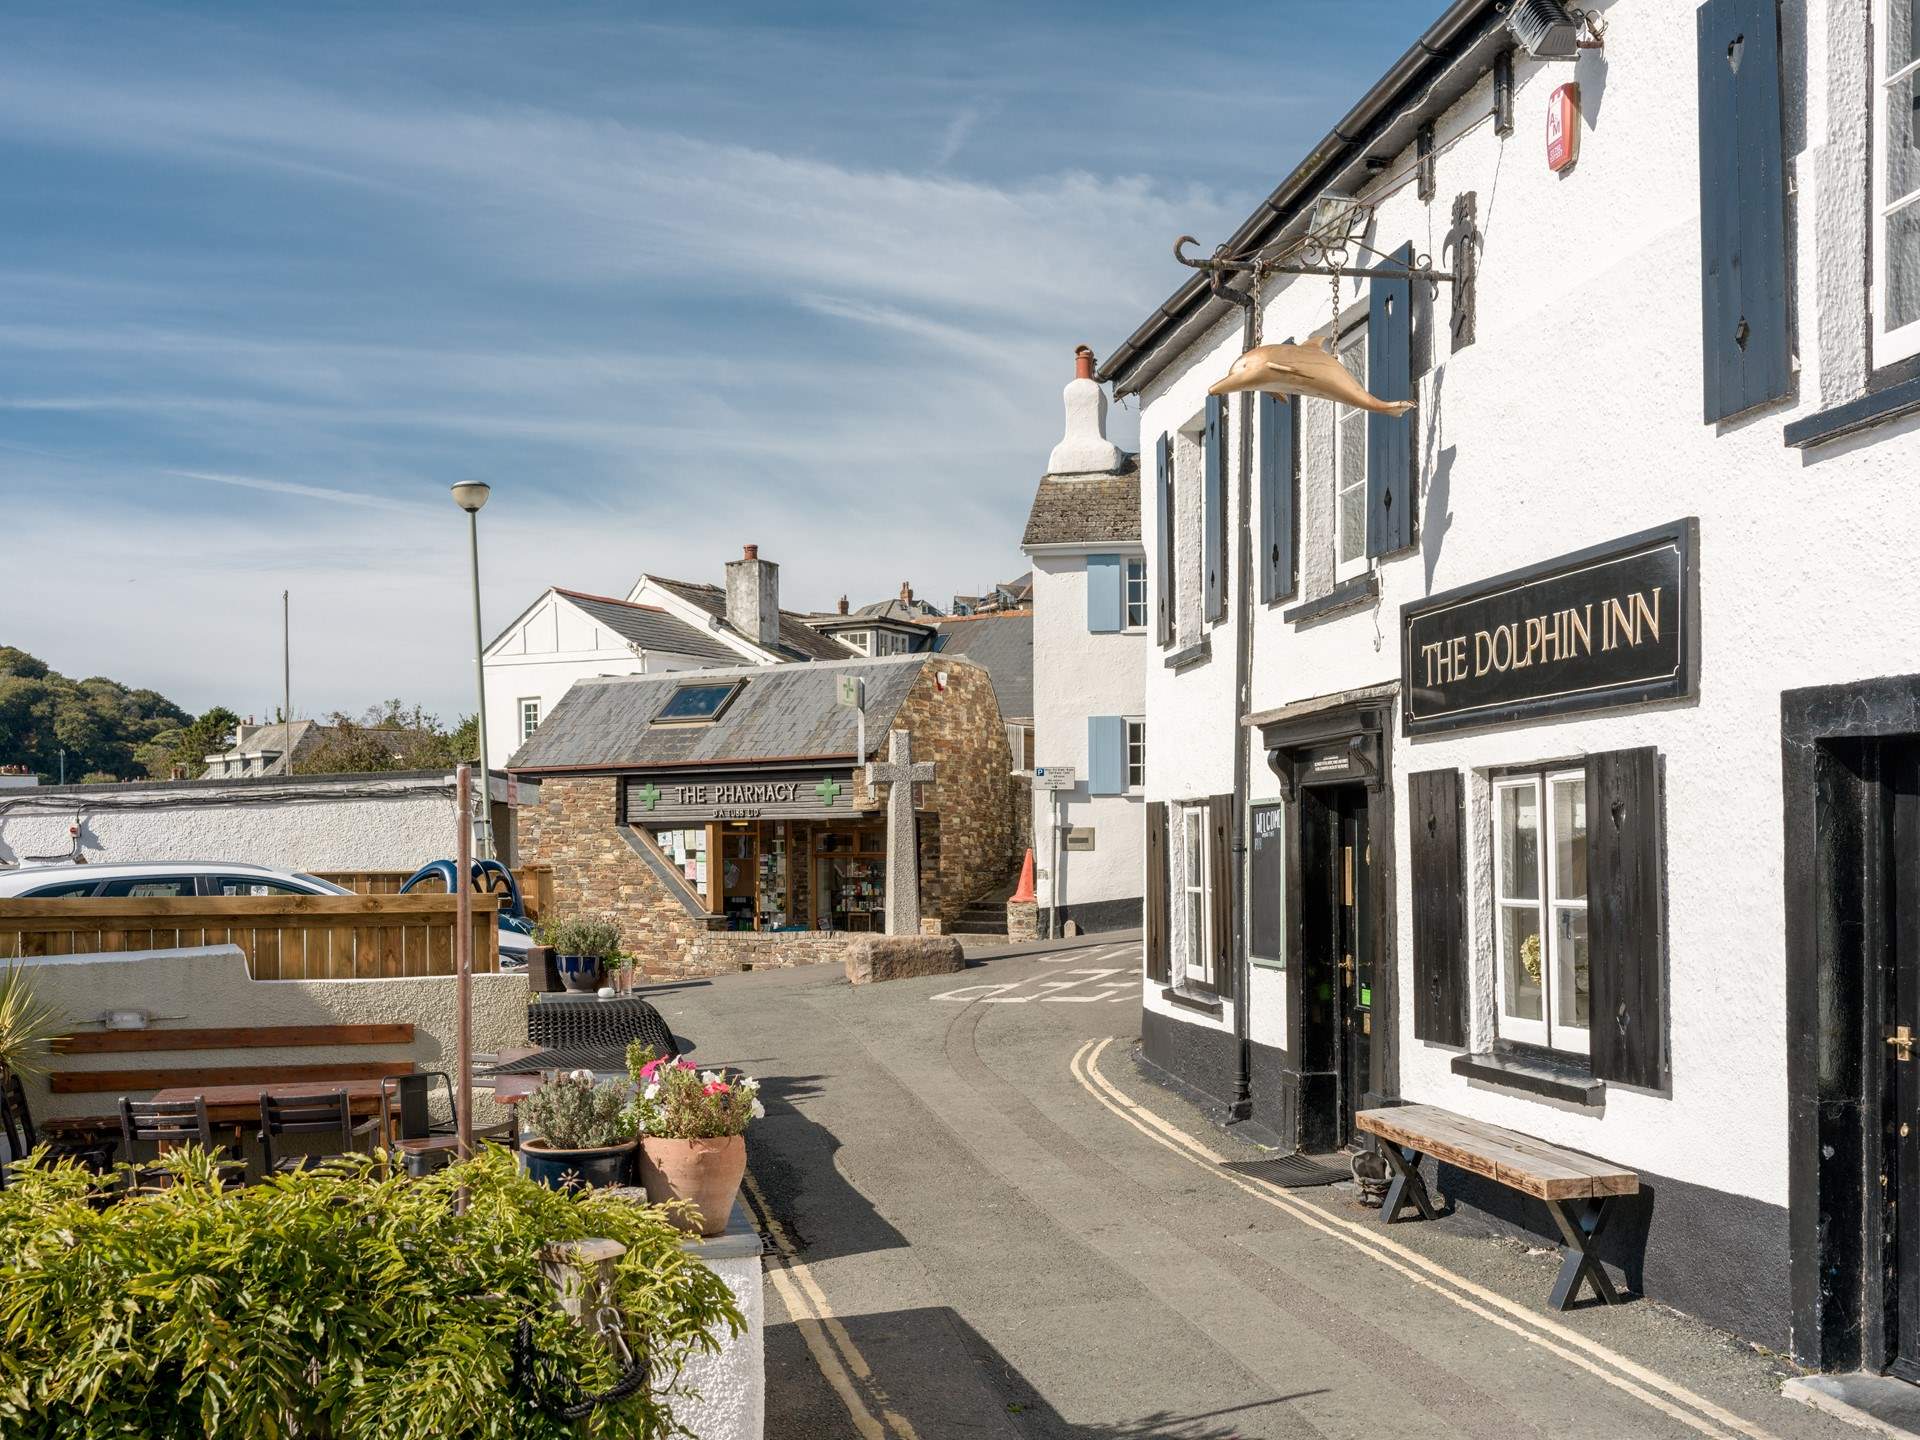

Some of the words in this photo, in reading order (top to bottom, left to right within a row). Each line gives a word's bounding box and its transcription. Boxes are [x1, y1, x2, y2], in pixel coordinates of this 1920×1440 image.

[1421, 636, 1469, 687] THE
[1474, 604, 1593, 677] DOLPHIN
[1601, 587, 1662, 651] INN
[675, 785, 706, 803] THE
[715, 783, 798, 802] PHARMACY
